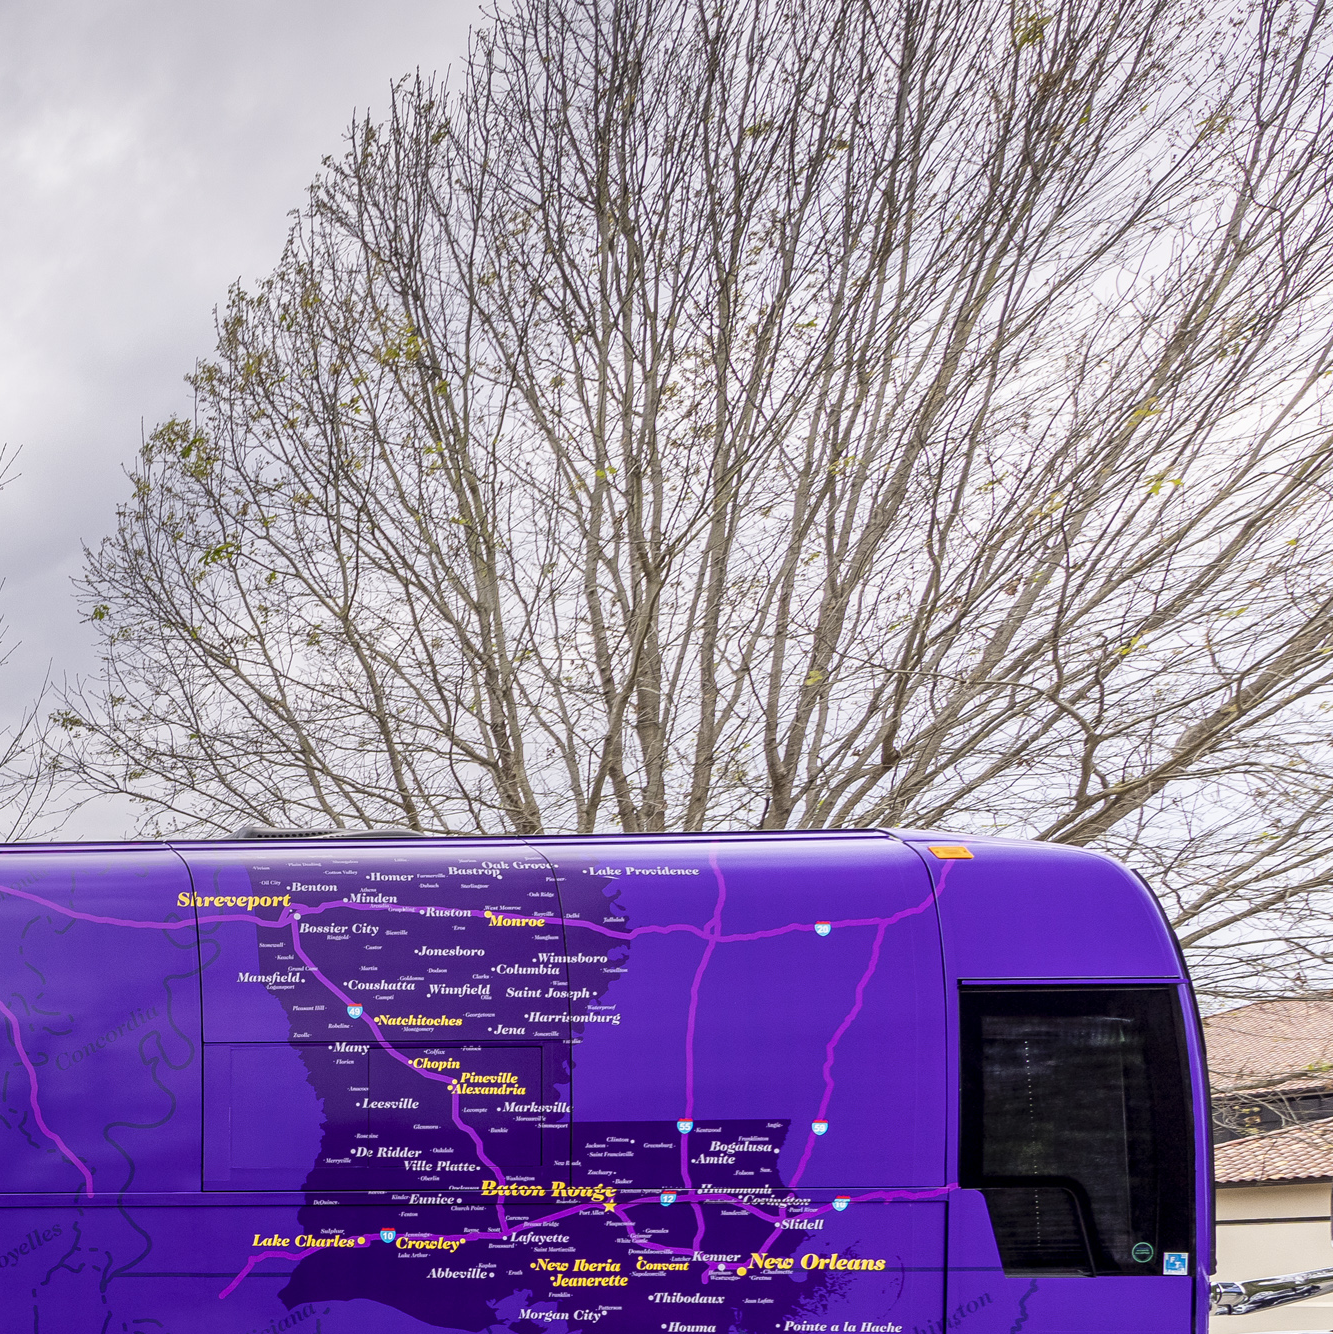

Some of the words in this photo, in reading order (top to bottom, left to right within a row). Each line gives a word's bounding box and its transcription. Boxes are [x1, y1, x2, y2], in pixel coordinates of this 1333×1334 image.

[481, 861, 510, 870] Oak
[512, 861, 552, 870] Grove
[589, 866, 622, 876] Lake
[623, 866, 700, 876] Providence
[370, 873, 414, 882] Homer
[448, 867, 501, 878] Bastrop
[291, 882, 338, 892] Benton
[176, 892, 291, 911] Shreveport
[348, 893, 398, 904] Minden
[425, 908, 472, 917] Ruston
[489, 914, 546, 927] Monroe
[299, 923, 348, 934] Bossier
[351, 923, 380, 936] City
[817, 925, 829, 934] 20
[418, 945, 485, 957] Jonesboro
[537, 953, 608, 964] Winnsboro
[496, 964, 560, 975] Columbia
[237, 972, 300, 983] Mansfield
[347, 979, 416, 991] Coushatta
[429, 983, 491, 996] Winnfield
[506, 987, 541, 998] Saint
[545, 988, 590, 1001] Joseph
[349, 1007, 360, 1015] 49
[379, 1014, 463, 1027] Natchitoches
[528, 1011, 621, 1025] Harrisonburg
[494, 1024, 526, 1035] Jena
[54, 1002, 162, 1075] Concordia
[333, 1042, 370, 1055] Many
[412, 1058, 461, 1071] Chopin
[460, 1072, 519, 1084] Pineville
[452, 1084, 527, 1095] Alexandria
[362, 1098, 419, 1109] Leesville
[502, 1101, 575, 1113] Marksville
[679, 1122, 690, 1131] 55
[814, 1124, 825, 1133] 59
[356, 1147, 373, 1158] De
[377, 1147, 422, 1159] Ridder
[709, 1141, 772, 1154] Bogalusa
[695, 1153, 735, 1164] Amite
[404, 1161, 433, 1172] Ville
[436, 1161, 475, 1172] Platte
[481, 1180, 546, 1197] Baton
[550, 1181, 618, 1202] Rouge
[701, 1184, 773, 1195] Hammond
[409, 1194, 455, 1205] Eunice
[663, 1195, 674, 1203] 12
[742, 1195, 811, 1209] Covington
[780, 1219, 824, 1230] Slidell
[252, 1234, 290, 1247] Lake
[294, 1235, 355, 1248] Charles
[382, 1232, 394, 1240] 10
[510, 1232, 570, 1245] Lafayette
[395, 1237, 460, 1253] Crowley
[691, 1251, 741, 1262] Kenner
[747, 1253, 795, 1269] New
[800, 1253, 887, 1271] Orleans
[535, 1258, 569, 1271] New
[572, 1258, 621, 1272] Iberia
[636, 1260, 690, 1271] Convent
[426, 1268, 488, 1280] Abbeville
[552, 1274, 629, 1287] Jeanerette
[653, 1292, 725, 1305] Thibodaux
[518, 1309, 569, 1322] Morgan
[573, 1309, 601, 1323] City
[667, 1322, 717, 1333] Houma
[784, 1321, 827, 1332] Pointe
[843, 1322, 856, 1332] la
[859, 1322, 902, 1333] Hache
